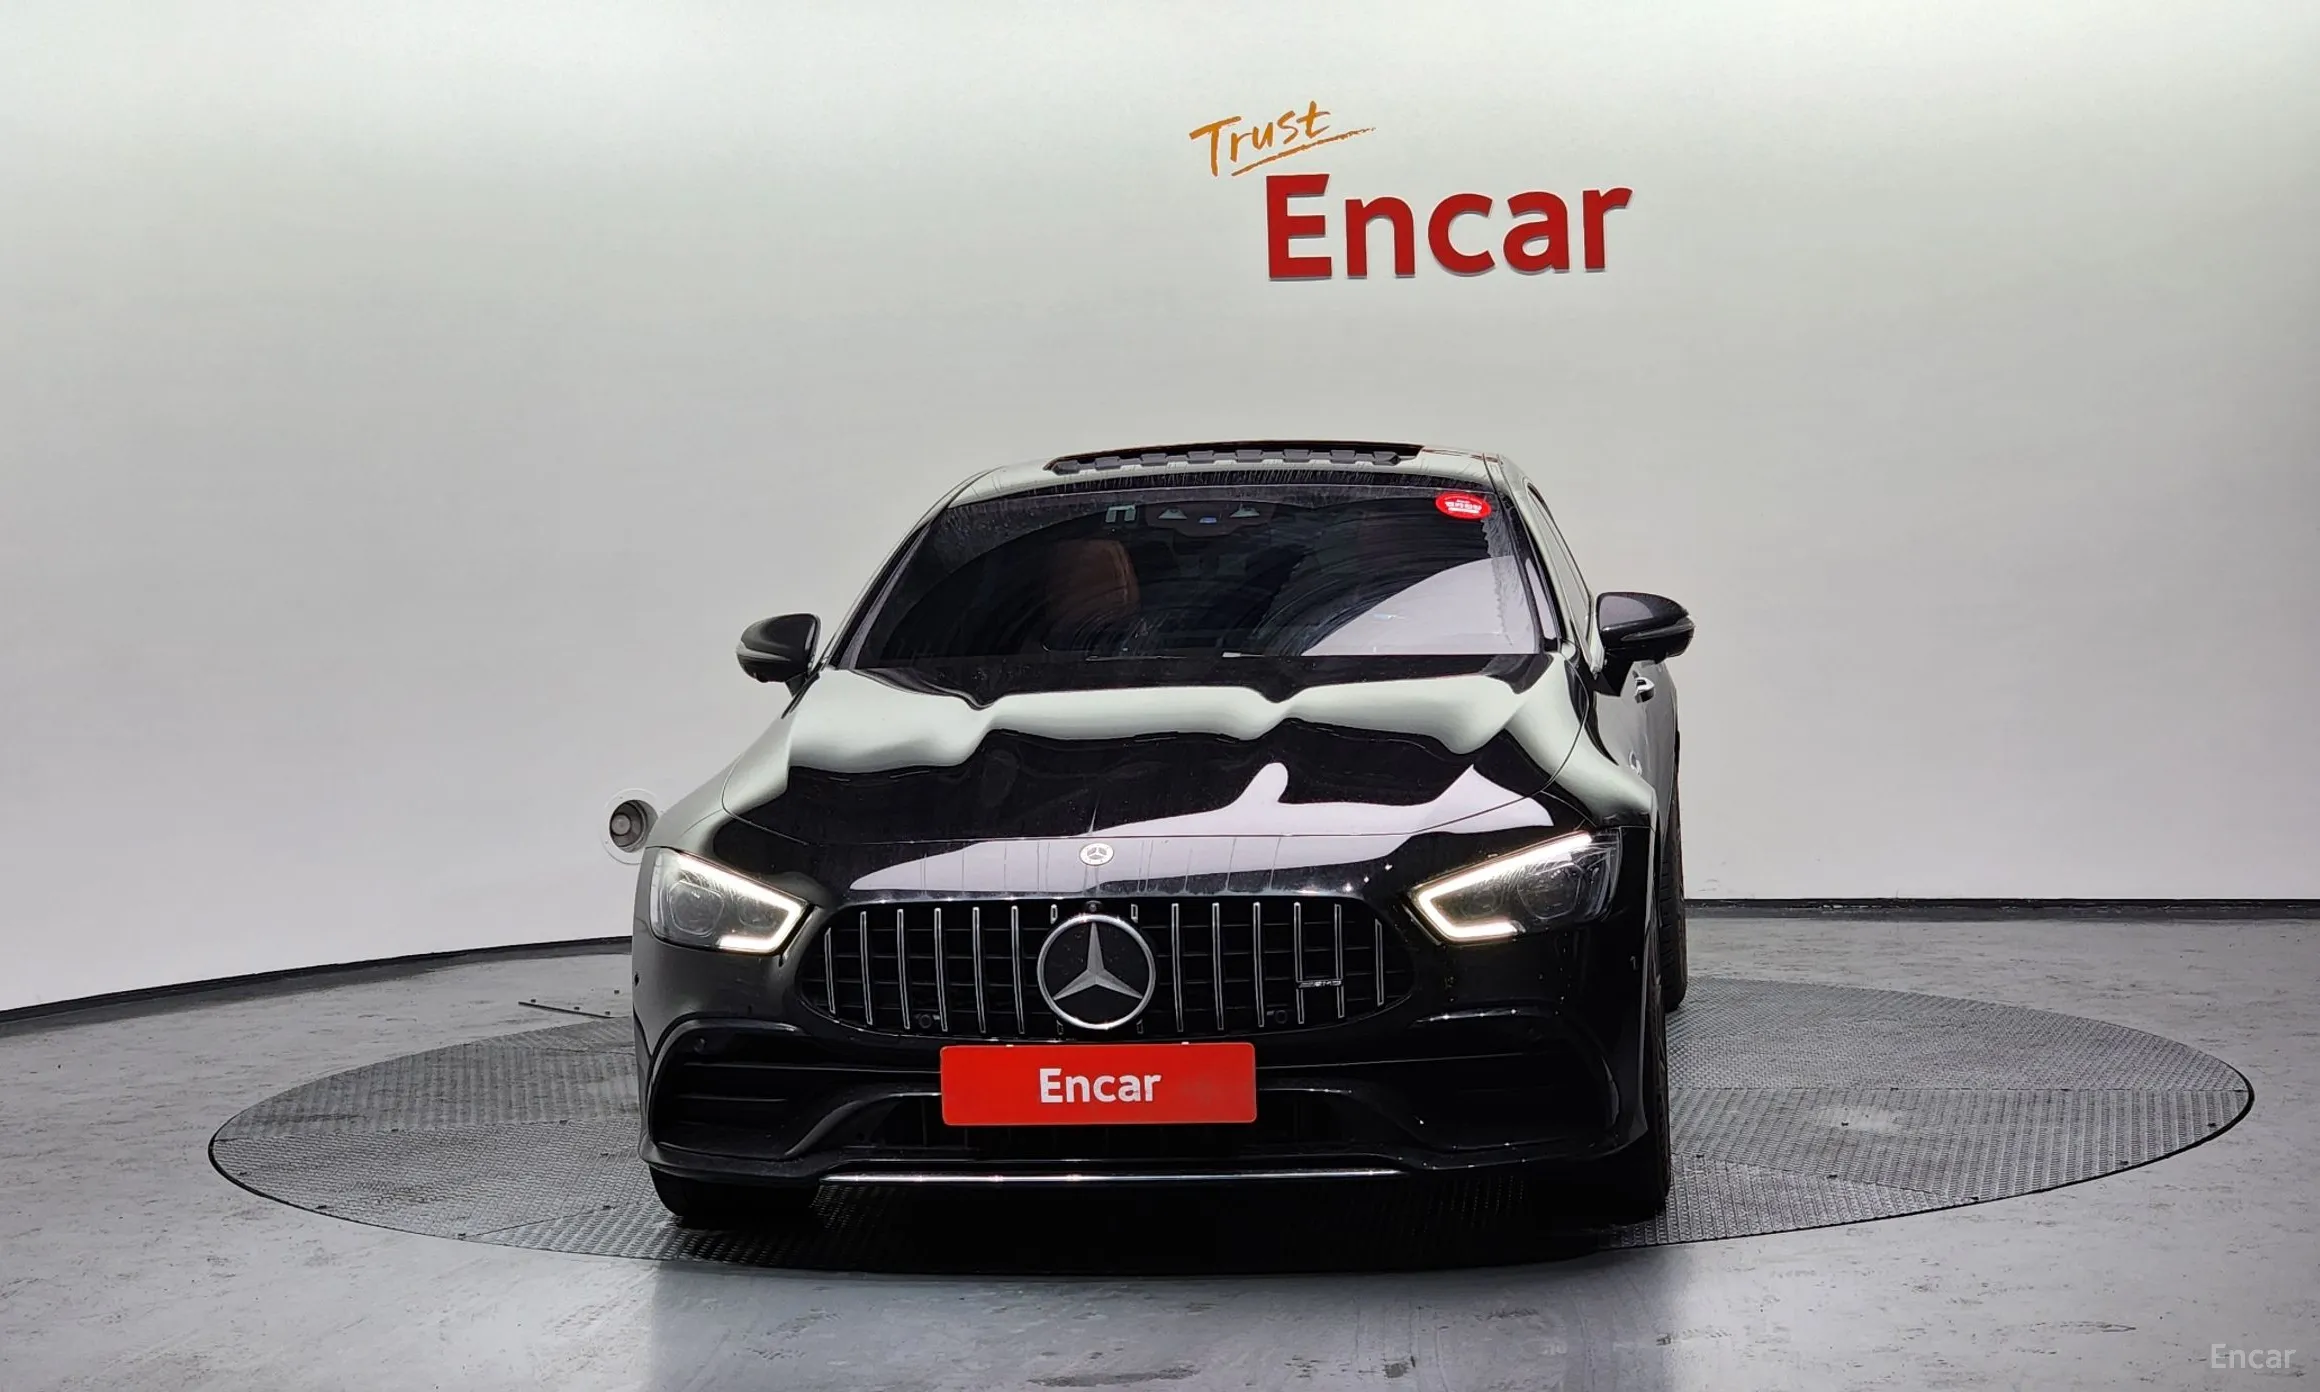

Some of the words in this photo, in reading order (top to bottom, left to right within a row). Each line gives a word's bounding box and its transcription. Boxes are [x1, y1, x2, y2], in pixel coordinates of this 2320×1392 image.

[1189, 100, 1331, 177] Trust
[1266, 173, 1633, 279] Encar
[1039, 1067, 1162, 1103] Encar
